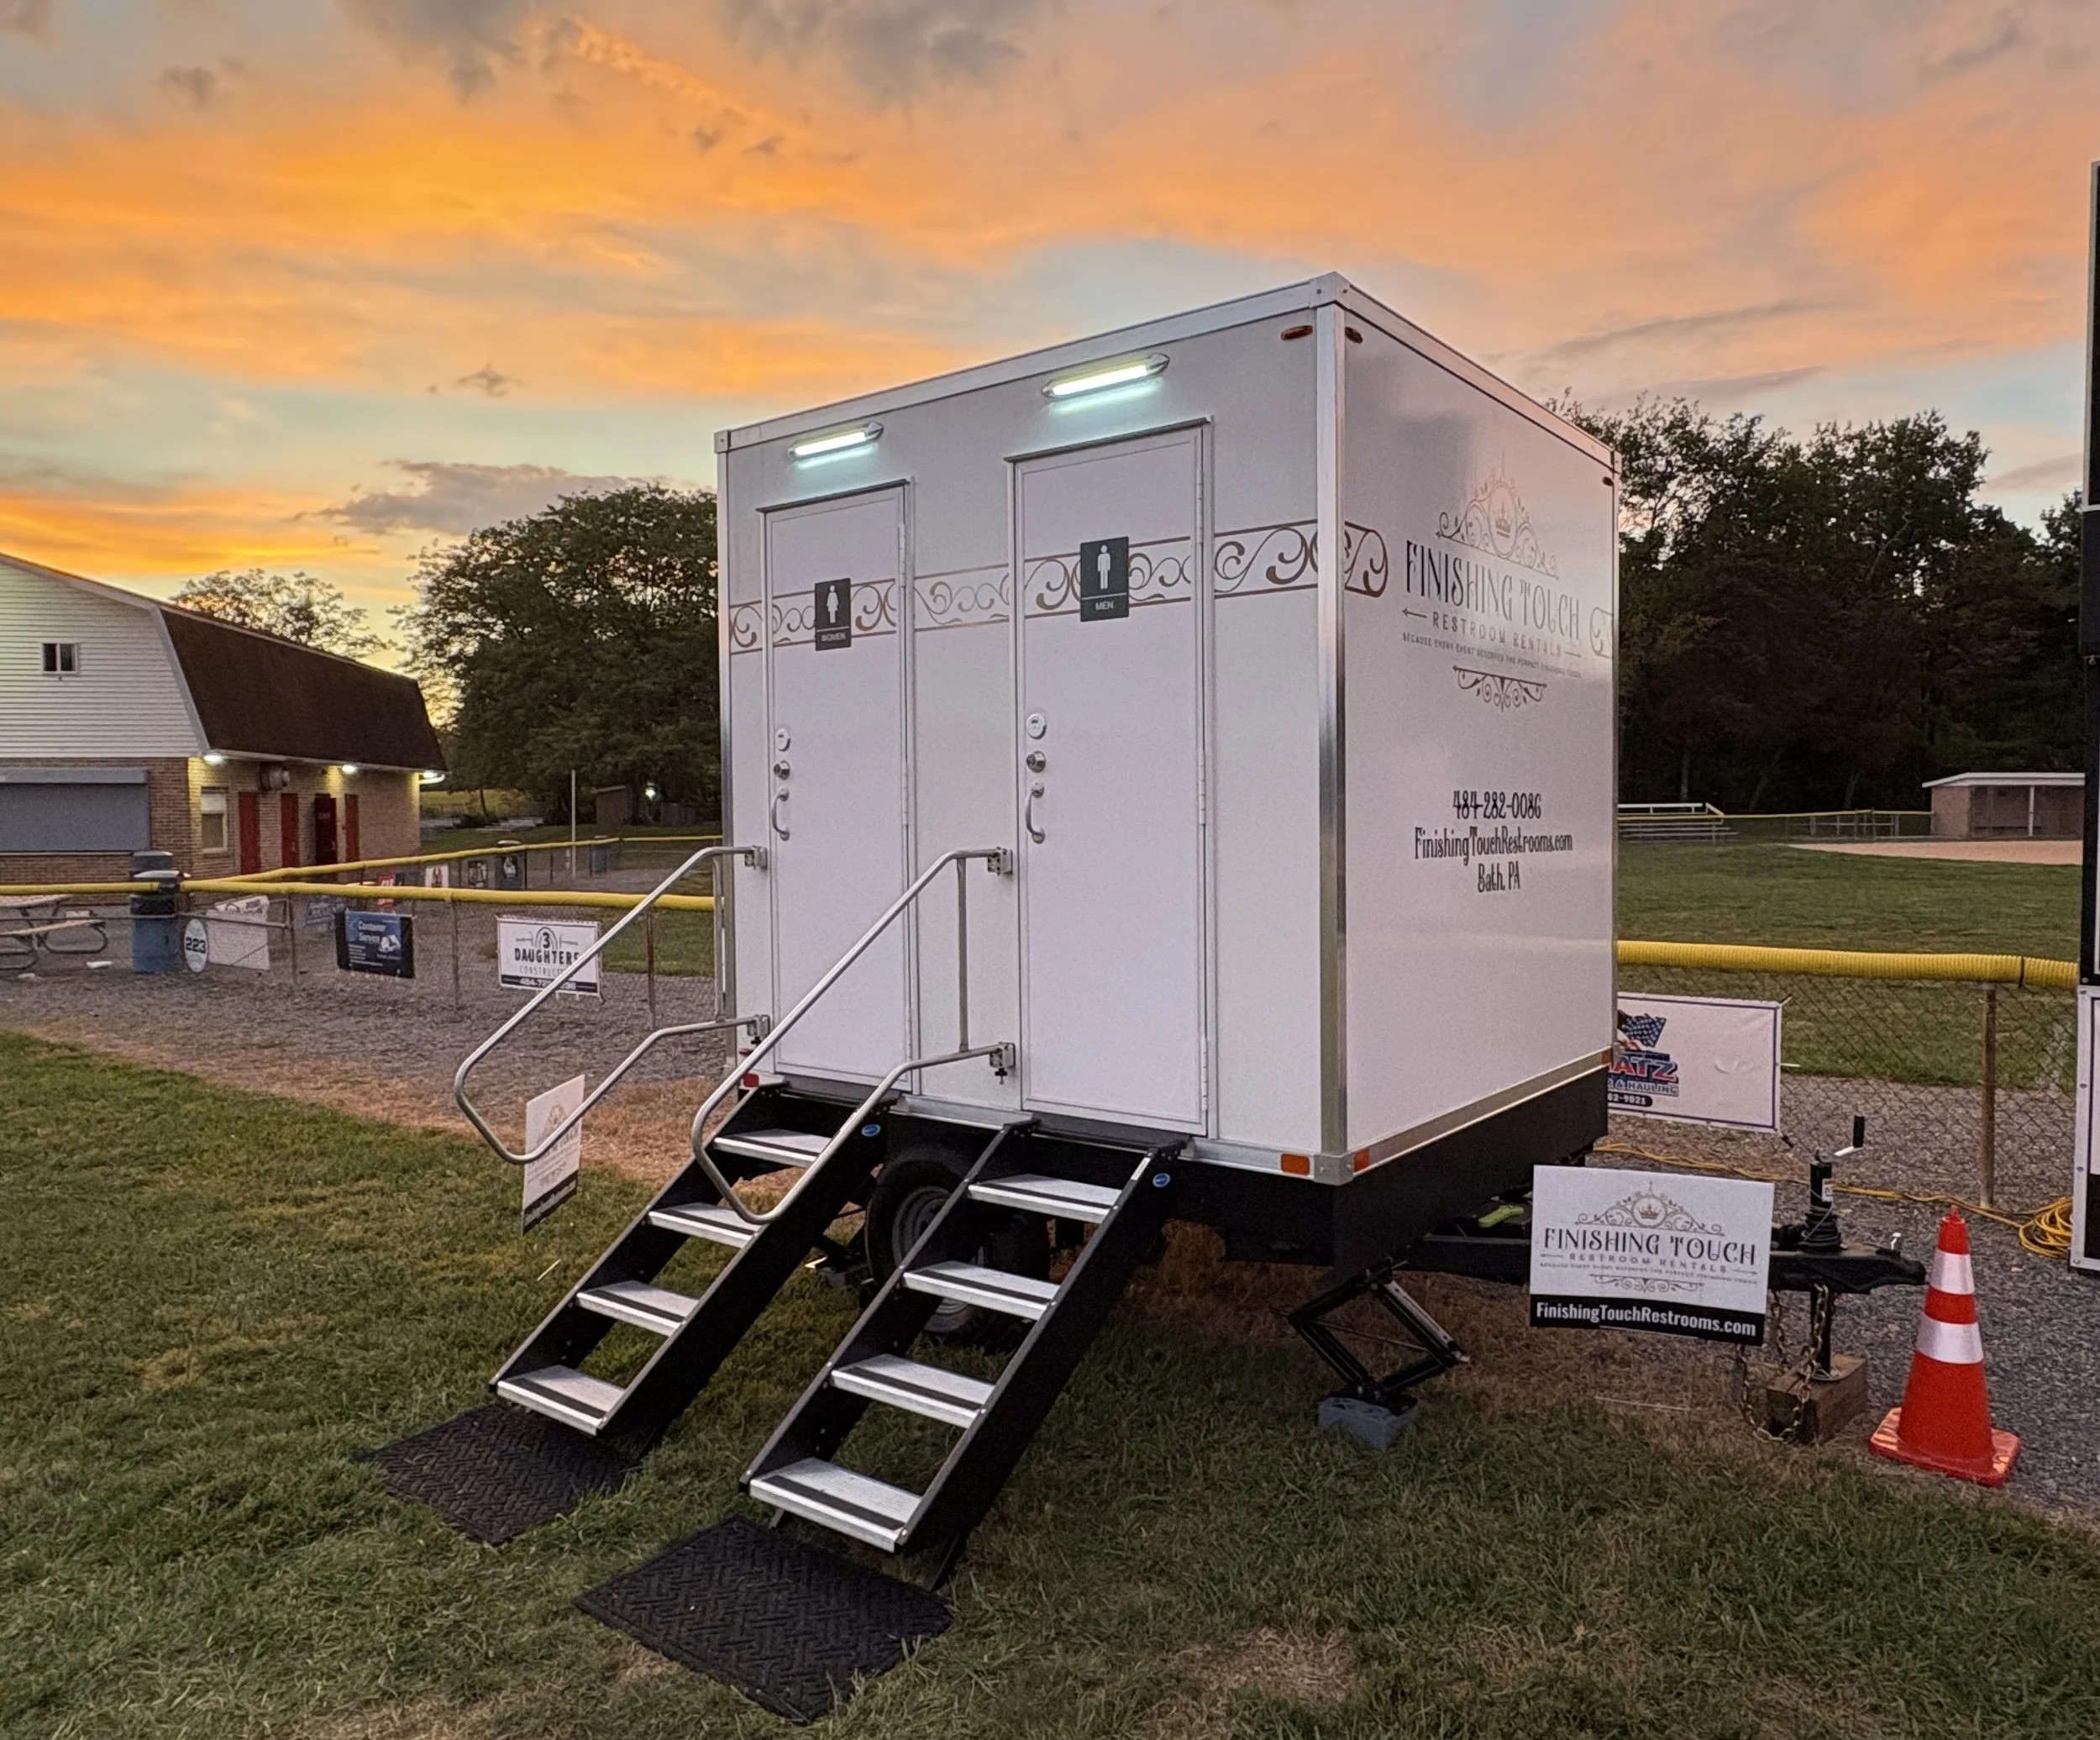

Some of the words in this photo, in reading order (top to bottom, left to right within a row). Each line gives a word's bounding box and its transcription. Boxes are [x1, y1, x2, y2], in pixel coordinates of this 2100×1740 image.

[1407, 540, 1513, 621] FINISHING
[1520, 579, 1580, 640] TOUCH
[1095, 602, 1114, 610] MEN
[1432, 611, 1507, 644] RESTROOM
[1512, 632, 1562, 658] RENTALS
[1452, 789, 1542, 820] 484-282-0086
[1414, 825, 1573, 866] FinishingTouchRestrooms.com
[1507, 859, 1521, 891] PA
[186, 937, 206, 954] 223
[543, 932, 550, 949] 3
[1609, 1056, 1676, 1080] ATZ
[1629, 1081, 1677, 1094] HAULING
[1543, 1227, 1661, 1255] FINISHING
[1669, 1237, 1757, 1266] TOUCH
[1568, 1253, 1651, 1265] RESTROOM
[1659, 1259, 1727, 1274] RENTALS
[1536, 1301, 1757, 1337] FinishingTouchRestrooms.com
